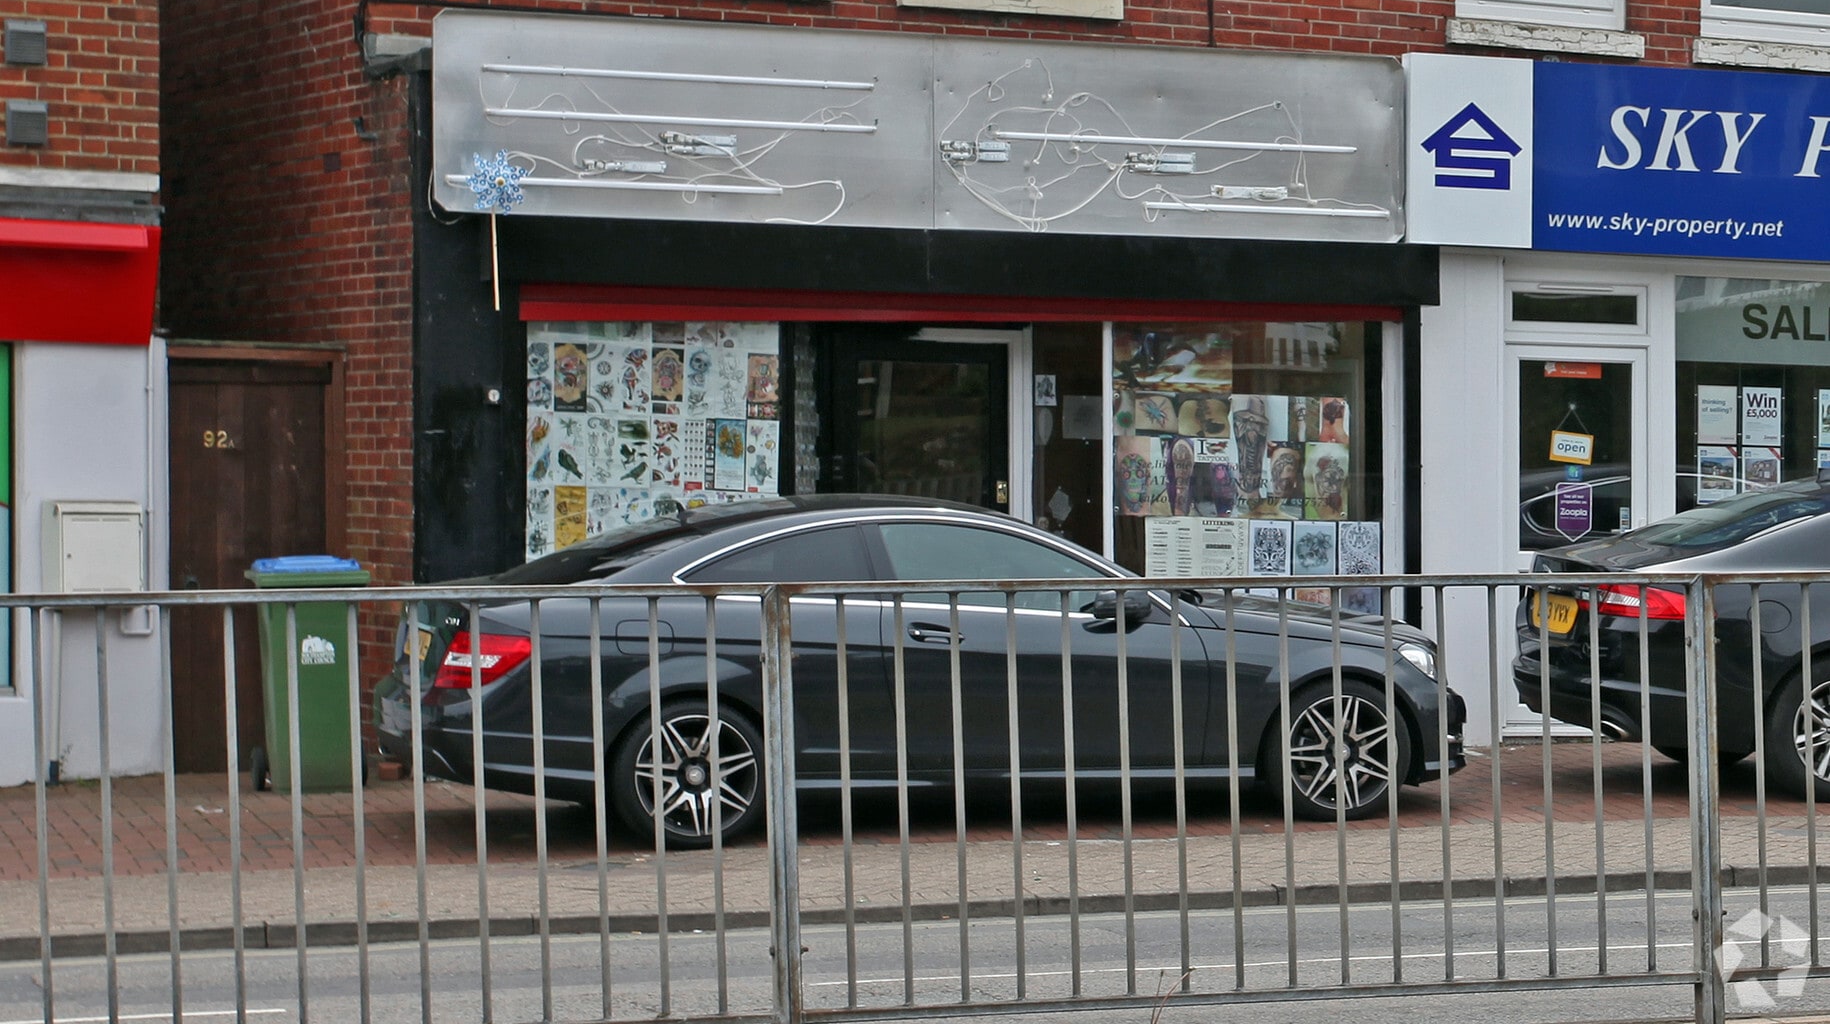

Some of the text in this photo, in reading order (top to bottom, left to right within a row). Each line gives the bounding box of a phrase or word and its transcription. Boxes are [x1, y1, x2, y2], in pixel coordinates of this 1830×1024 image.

[1597, 105, 1766, 174] SKY
[1548, 212, 1784, 239] www.sky-property.net
[1742, 303, 1830, 342] SAL
[1746, 393, 1778, 408] Win
[1746, 408, 1778, 419] £5,000
[1557, 442, 1586, 453] open
[1560, 507, 1588, 517] Zoopla
